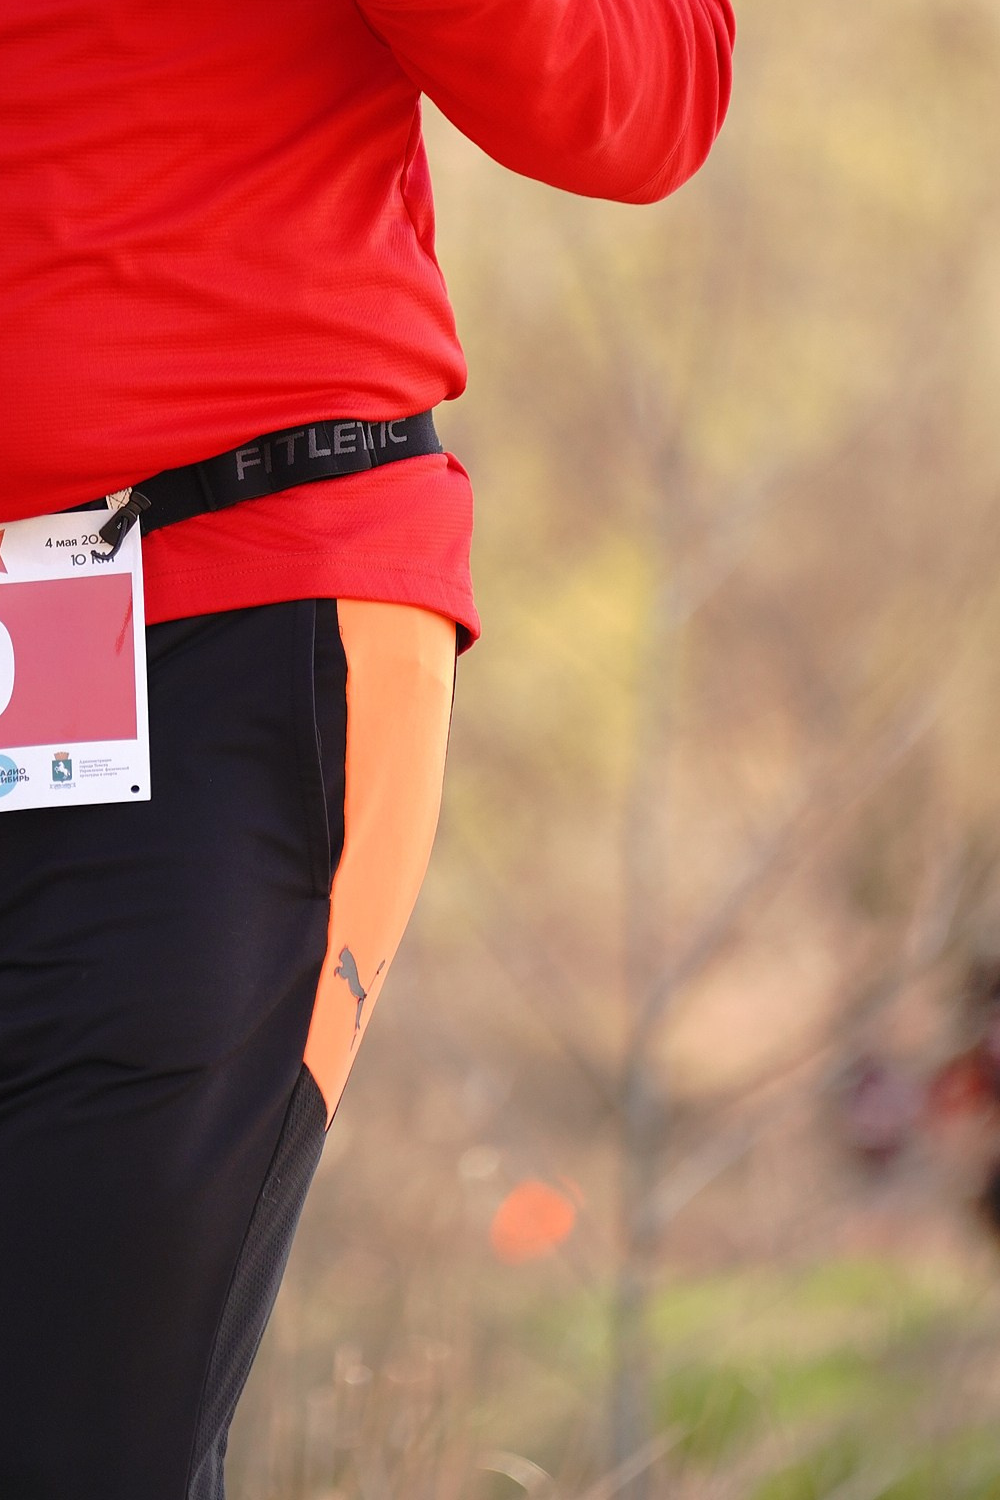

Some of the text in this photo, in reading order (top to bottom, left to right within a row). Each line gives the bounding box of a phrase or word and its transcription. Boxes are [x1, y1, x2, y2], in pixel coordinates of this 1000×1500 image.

[44, 537, 53, 549] 4
[56, 538, 78, 548] мая
[71, 553, 87, 567] 10
